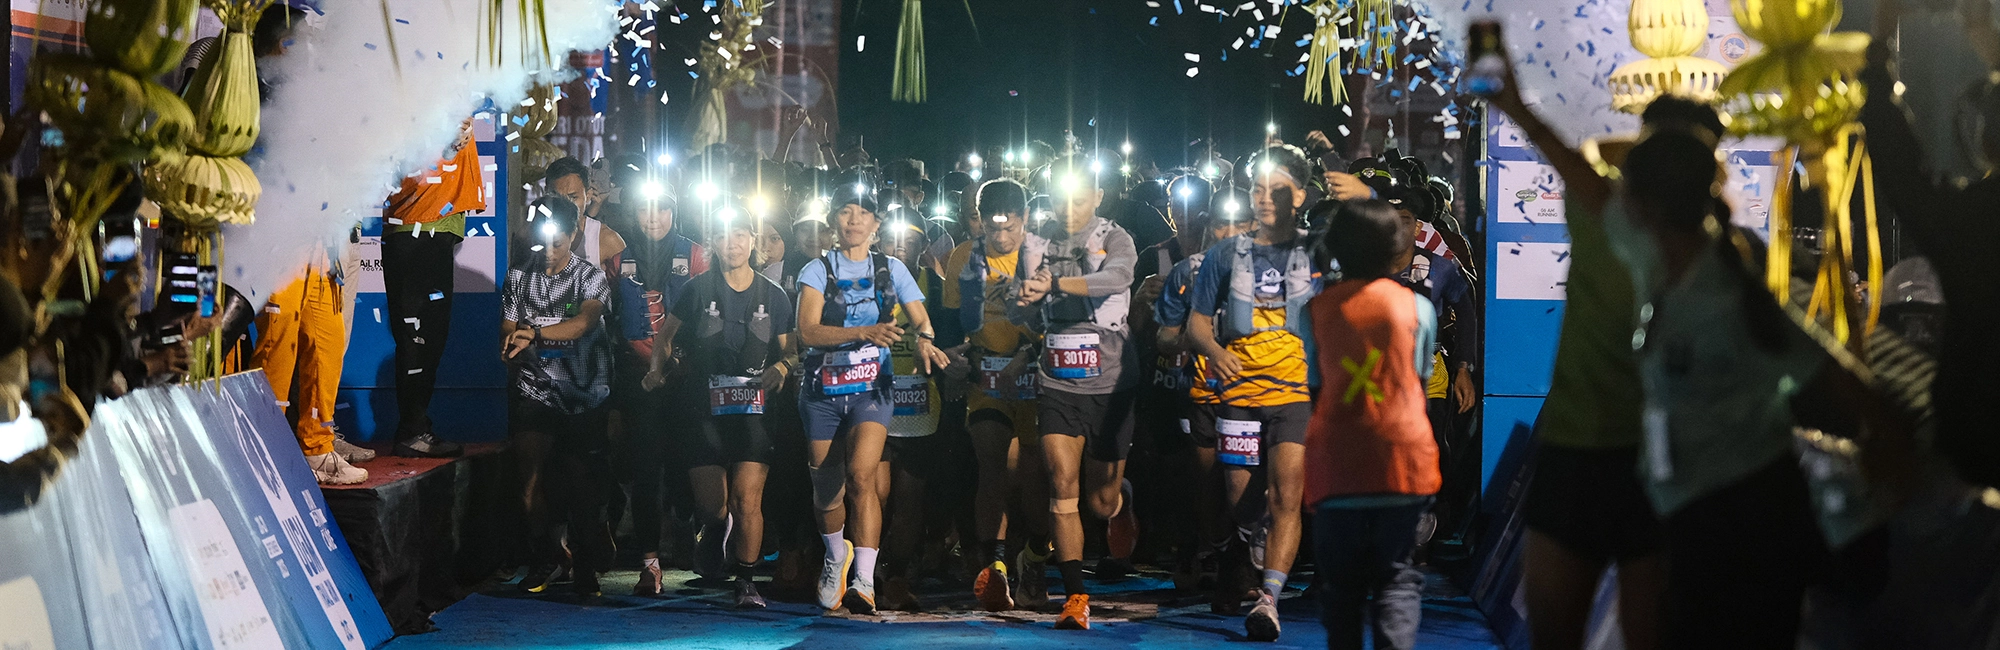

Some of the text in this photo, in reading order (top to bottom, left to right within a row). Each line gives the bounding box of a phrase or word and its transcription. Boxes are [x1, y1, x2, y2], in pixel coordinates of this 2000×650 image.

[1063, 350, 1098, 365] 30178
[844, 363, 878, 381] 35023
[731, 388, 761, 402] 35081
[894, 389, 927, 404] 30323
[1225, 436, 1259, 452] 30206
